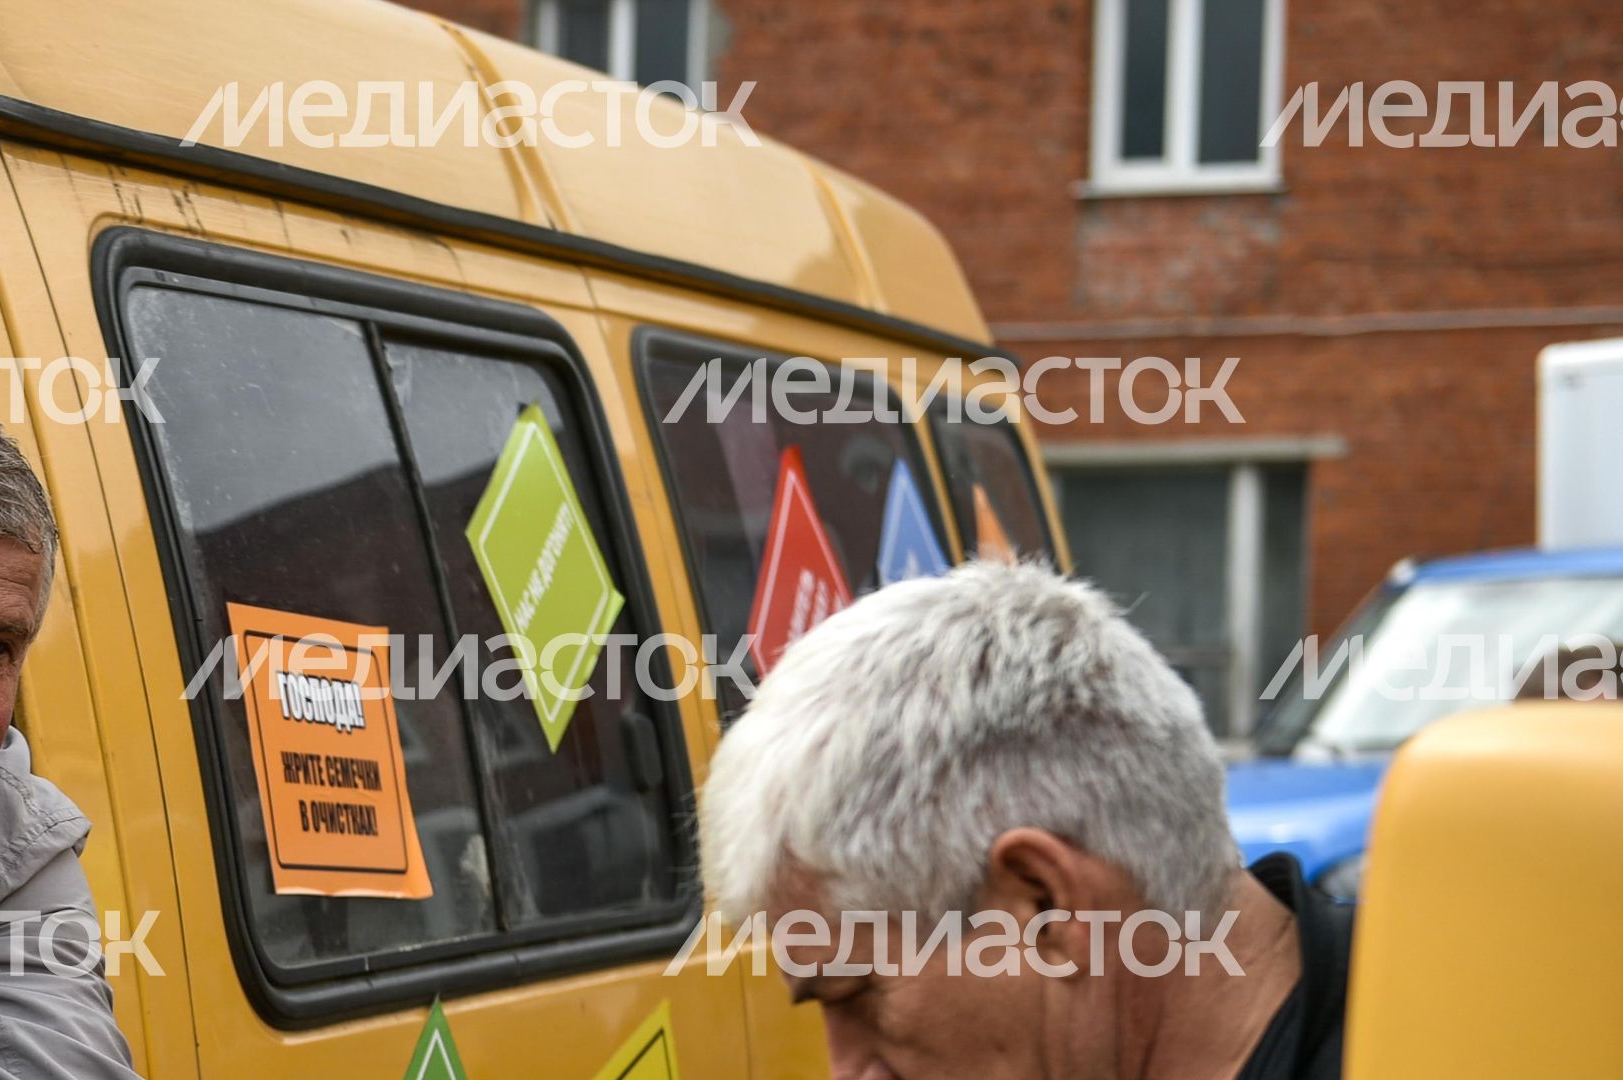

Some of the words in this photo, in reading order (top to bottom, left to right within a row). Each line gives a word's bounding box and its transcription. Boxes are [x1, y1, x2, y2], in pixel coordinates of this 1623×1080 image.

[277, 671, 366, 734] ГОСПОДА!
[281, 751, 325, 786] ЖРИТЕ
[325, 756, 383, 791] СЕМЕЧКИ
[299, 800, 310, 831] В
[311, 801, 379, 836] ОЧИСТКАХ!
